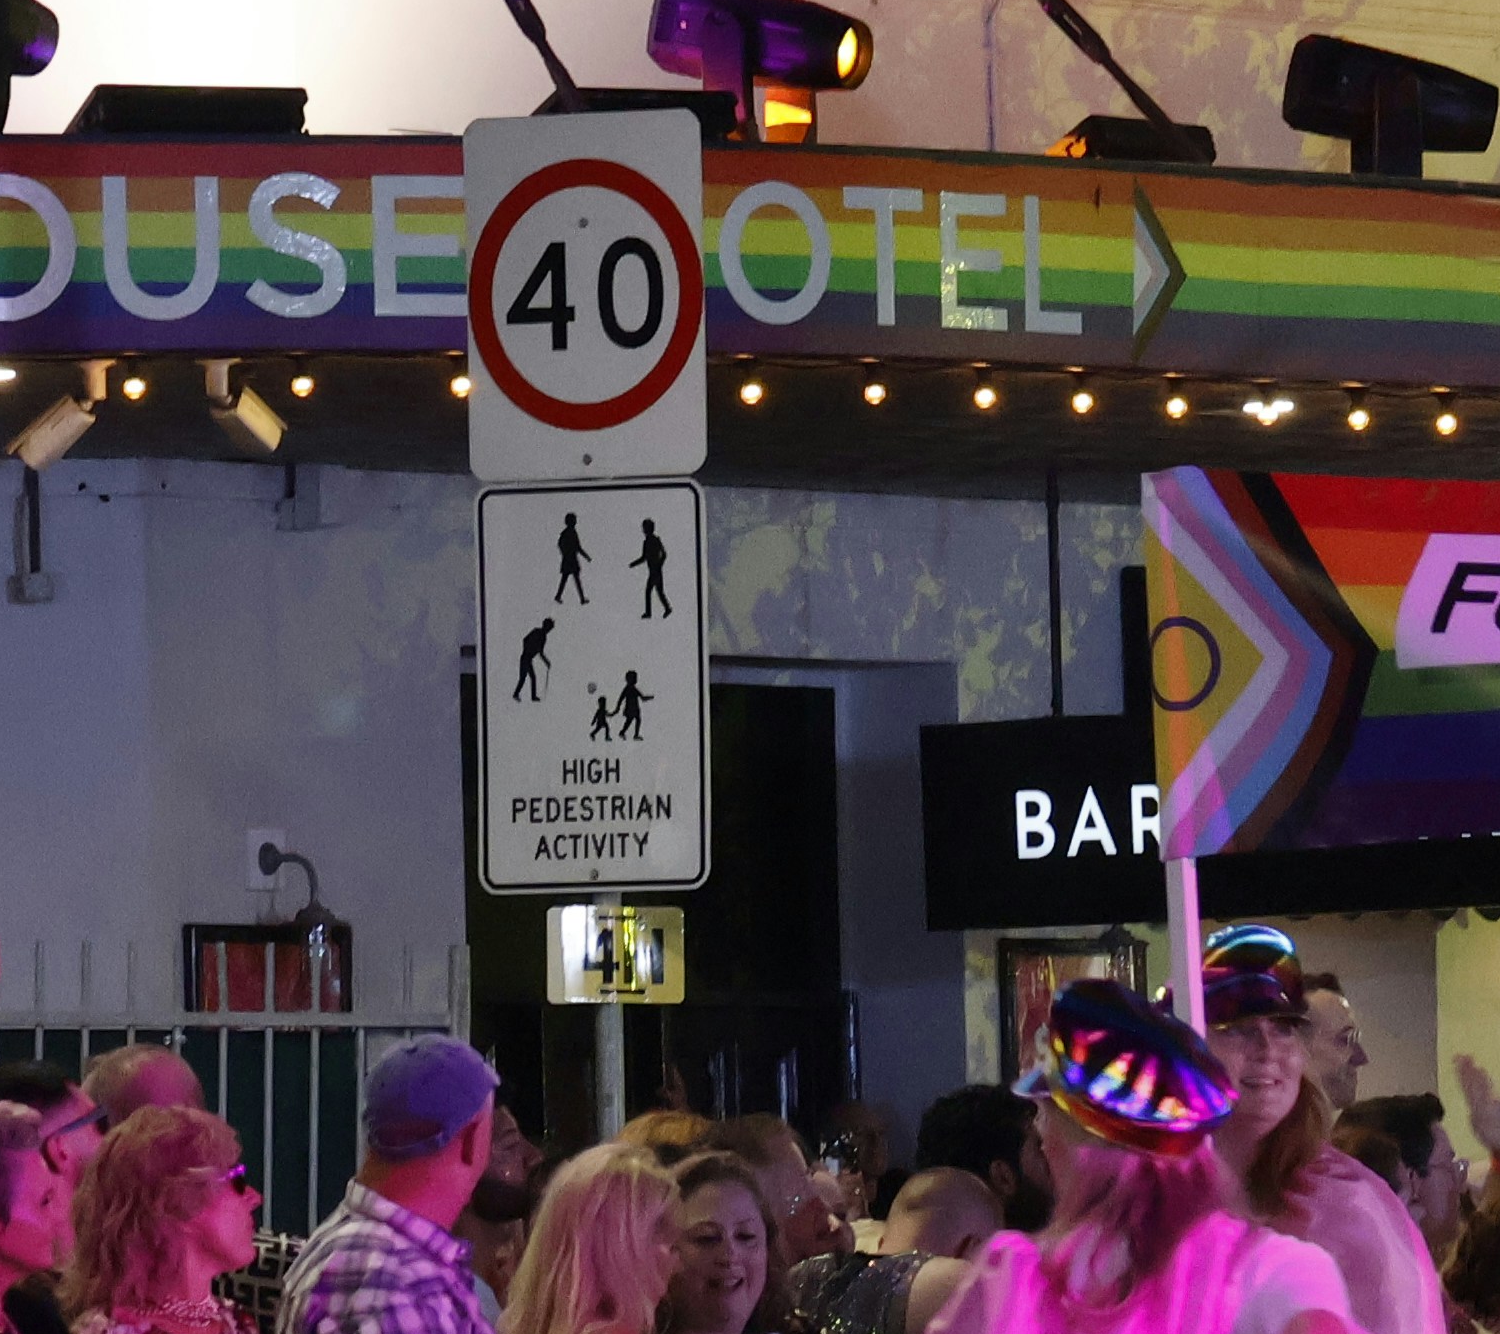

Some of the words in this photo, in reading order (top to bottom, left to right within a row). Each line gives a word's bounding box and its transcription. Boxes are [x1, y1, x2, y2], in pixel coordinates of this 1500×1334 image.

[718, 180, 1084, 335] OTEL
[506, 236, 664, 352] 40
[562, 758, 621, 785] HIGH
[511, 795, 673, 825] PEDESTRIAN
[1015, 784, 1162, 861] BAR
[535, 832, 649, 861] ACTIVITY
